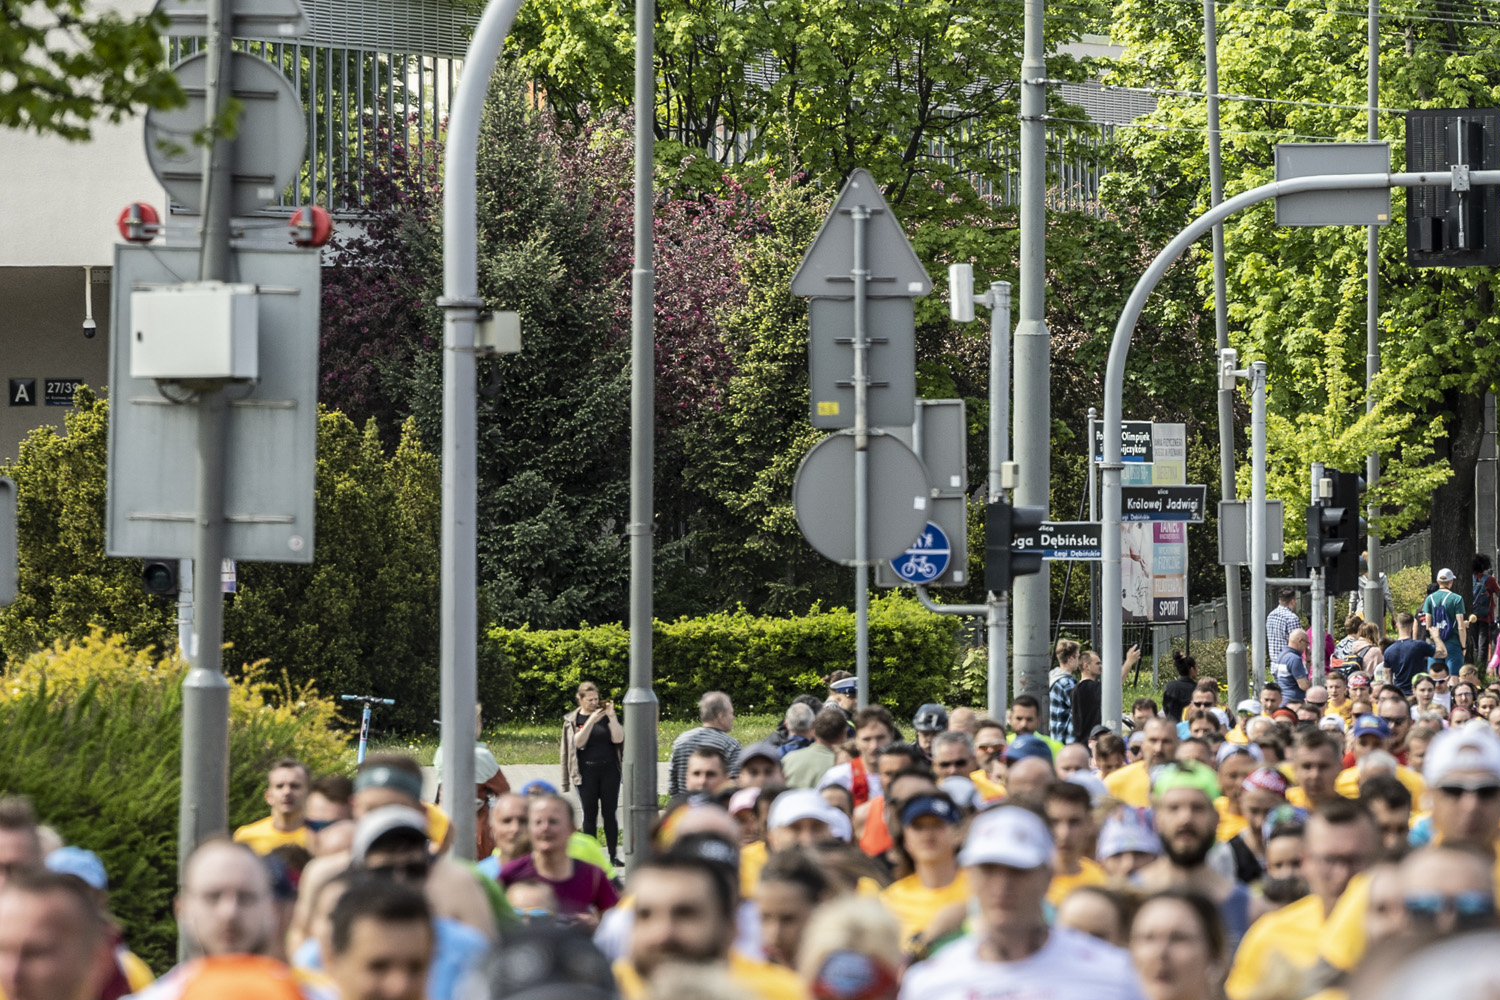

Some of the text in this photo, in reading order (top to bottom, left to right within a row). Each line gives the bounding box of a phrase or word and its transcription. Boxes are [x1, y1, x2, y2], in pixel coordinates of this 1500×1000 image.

[14, 383, 30, 403] A
[1121, 431, 1151, 443] Olimpijek
[1127, 498, 1199, 512] Królowej Jadwigi
[1041, 534, 1098, 549] Dębińska
[1159, 601, 1179, 616] SPORT
